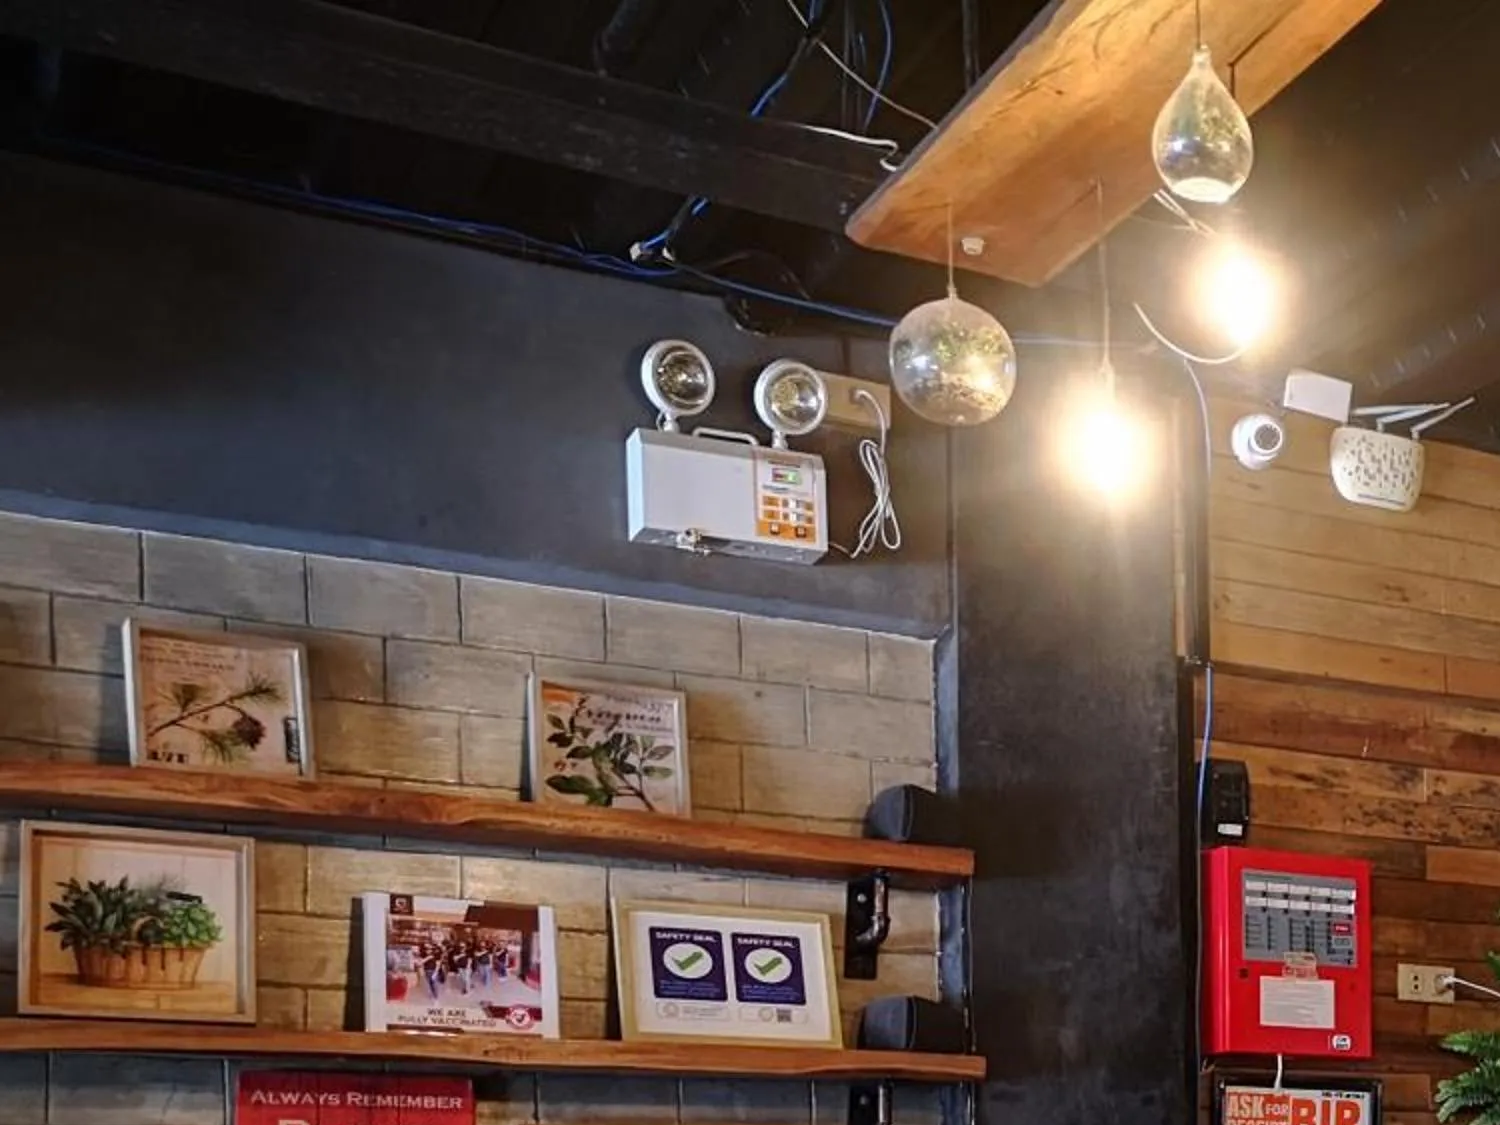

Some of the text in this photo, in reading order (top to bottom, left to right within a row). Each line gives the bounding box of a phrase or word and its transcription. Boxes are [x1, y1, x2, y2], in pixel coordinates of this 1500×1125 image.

[251, 1090, 464, 1110] ALWAYS REMEMBER
[1227, 1095, 1289, 1119] ASK FOR
